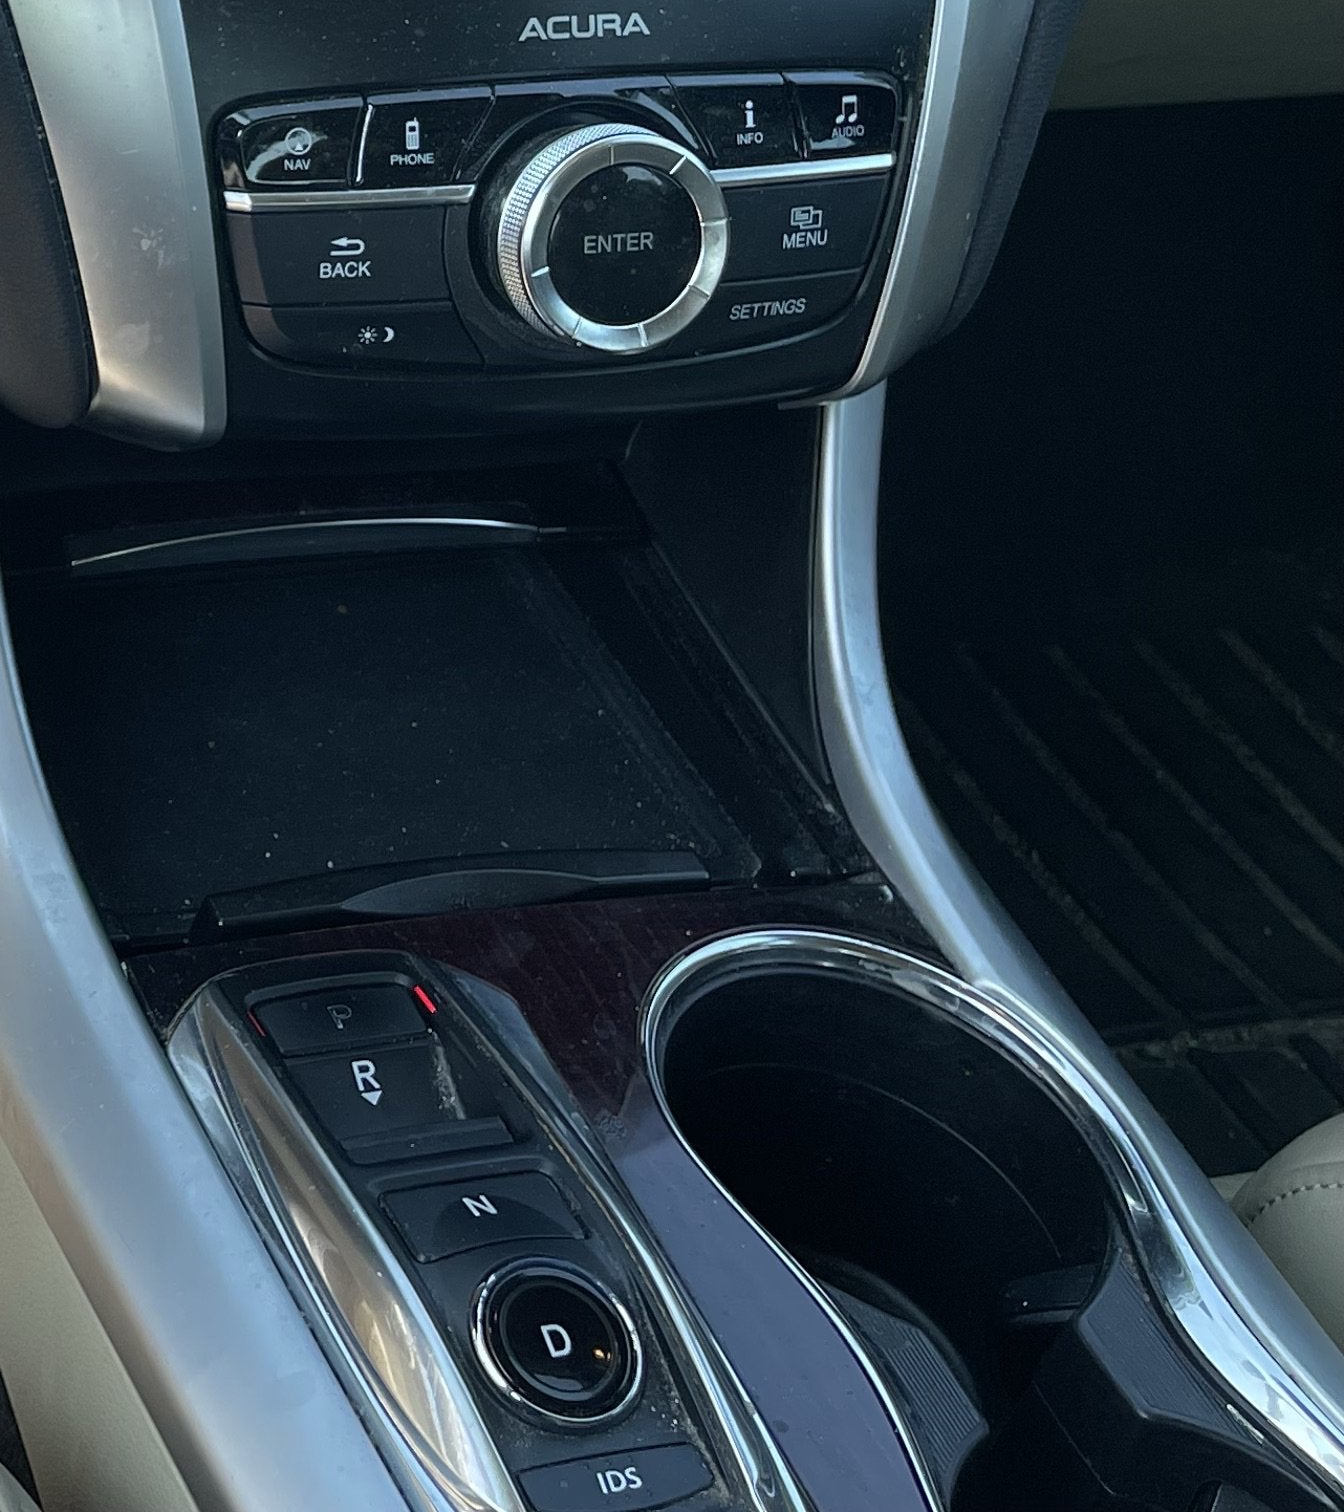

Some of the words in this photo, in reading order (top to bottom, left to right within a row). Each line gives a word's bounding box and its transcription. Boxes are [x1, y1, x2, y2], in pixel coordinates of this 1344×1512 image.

[518, 12, 651, 43] ACURA
[736, 131, 764, 146] INFO
[831, 124, 865, 139] AUDIO
[283, 157, 312, 172] NAV
[389, 152, 435, 167] PHONE
[583, 231, 654, 256] ENTER
[781, 229, 828, 249] MENU
[318, 260, 371, 281] BACK
[728, 298, 806, 322] SETTINGS
[326, 1004, 353, 1031] P
[350, 1059, 382, 1093] R
[461, 1193, 499, 1219] N
[539, 1323, 573, 1360] D
[596, 1465, 643, 1496] IDS
